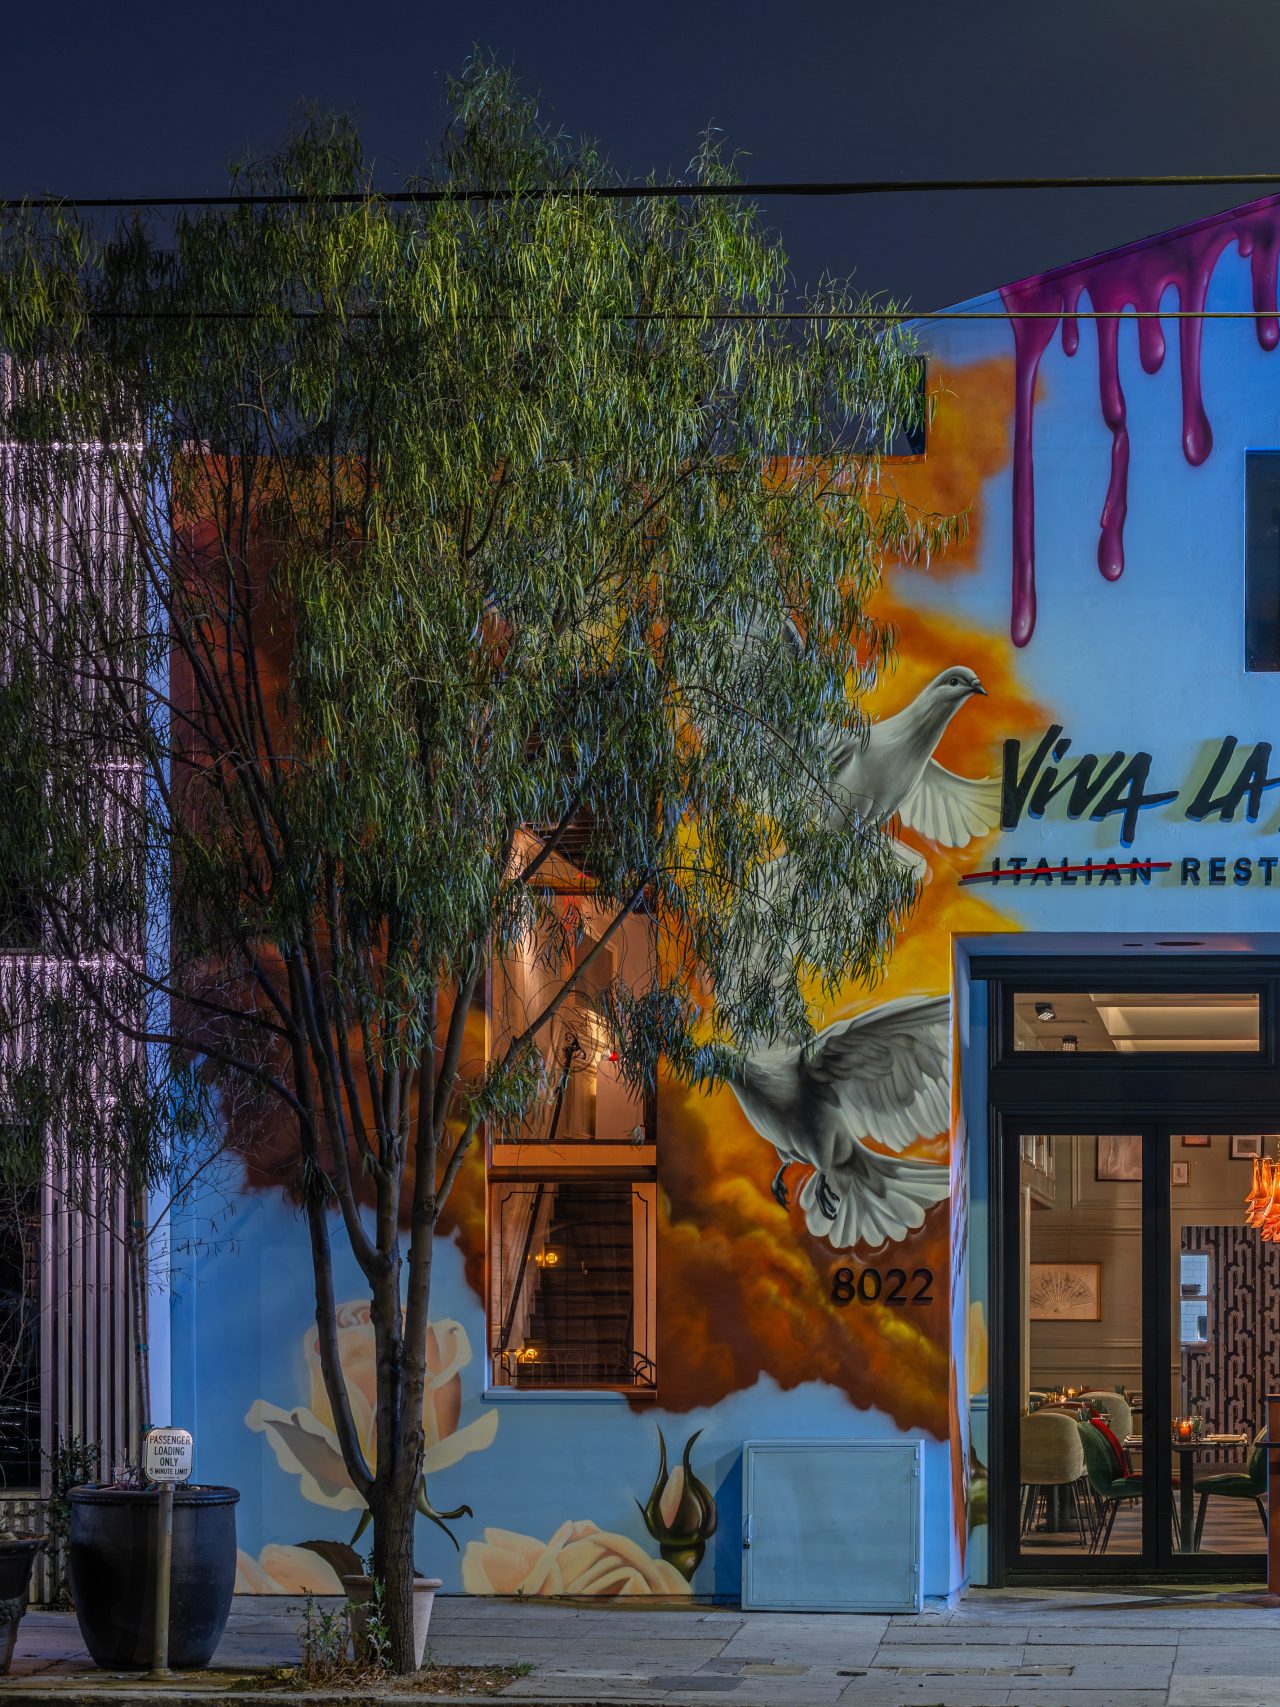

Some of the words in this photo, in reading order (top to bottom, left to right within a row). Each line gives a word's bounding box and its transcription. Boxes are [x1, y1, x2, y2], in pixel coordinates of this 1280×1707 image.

[992, 857, 1153, 886] ITALIAN
[831, 1268, 934, 1306] 8022
[149, 1435, 190, 1445] PASSENGER
[154, 1446, 185, 1456] LOADING
[160, 1457, 178, 1467] ONLY
